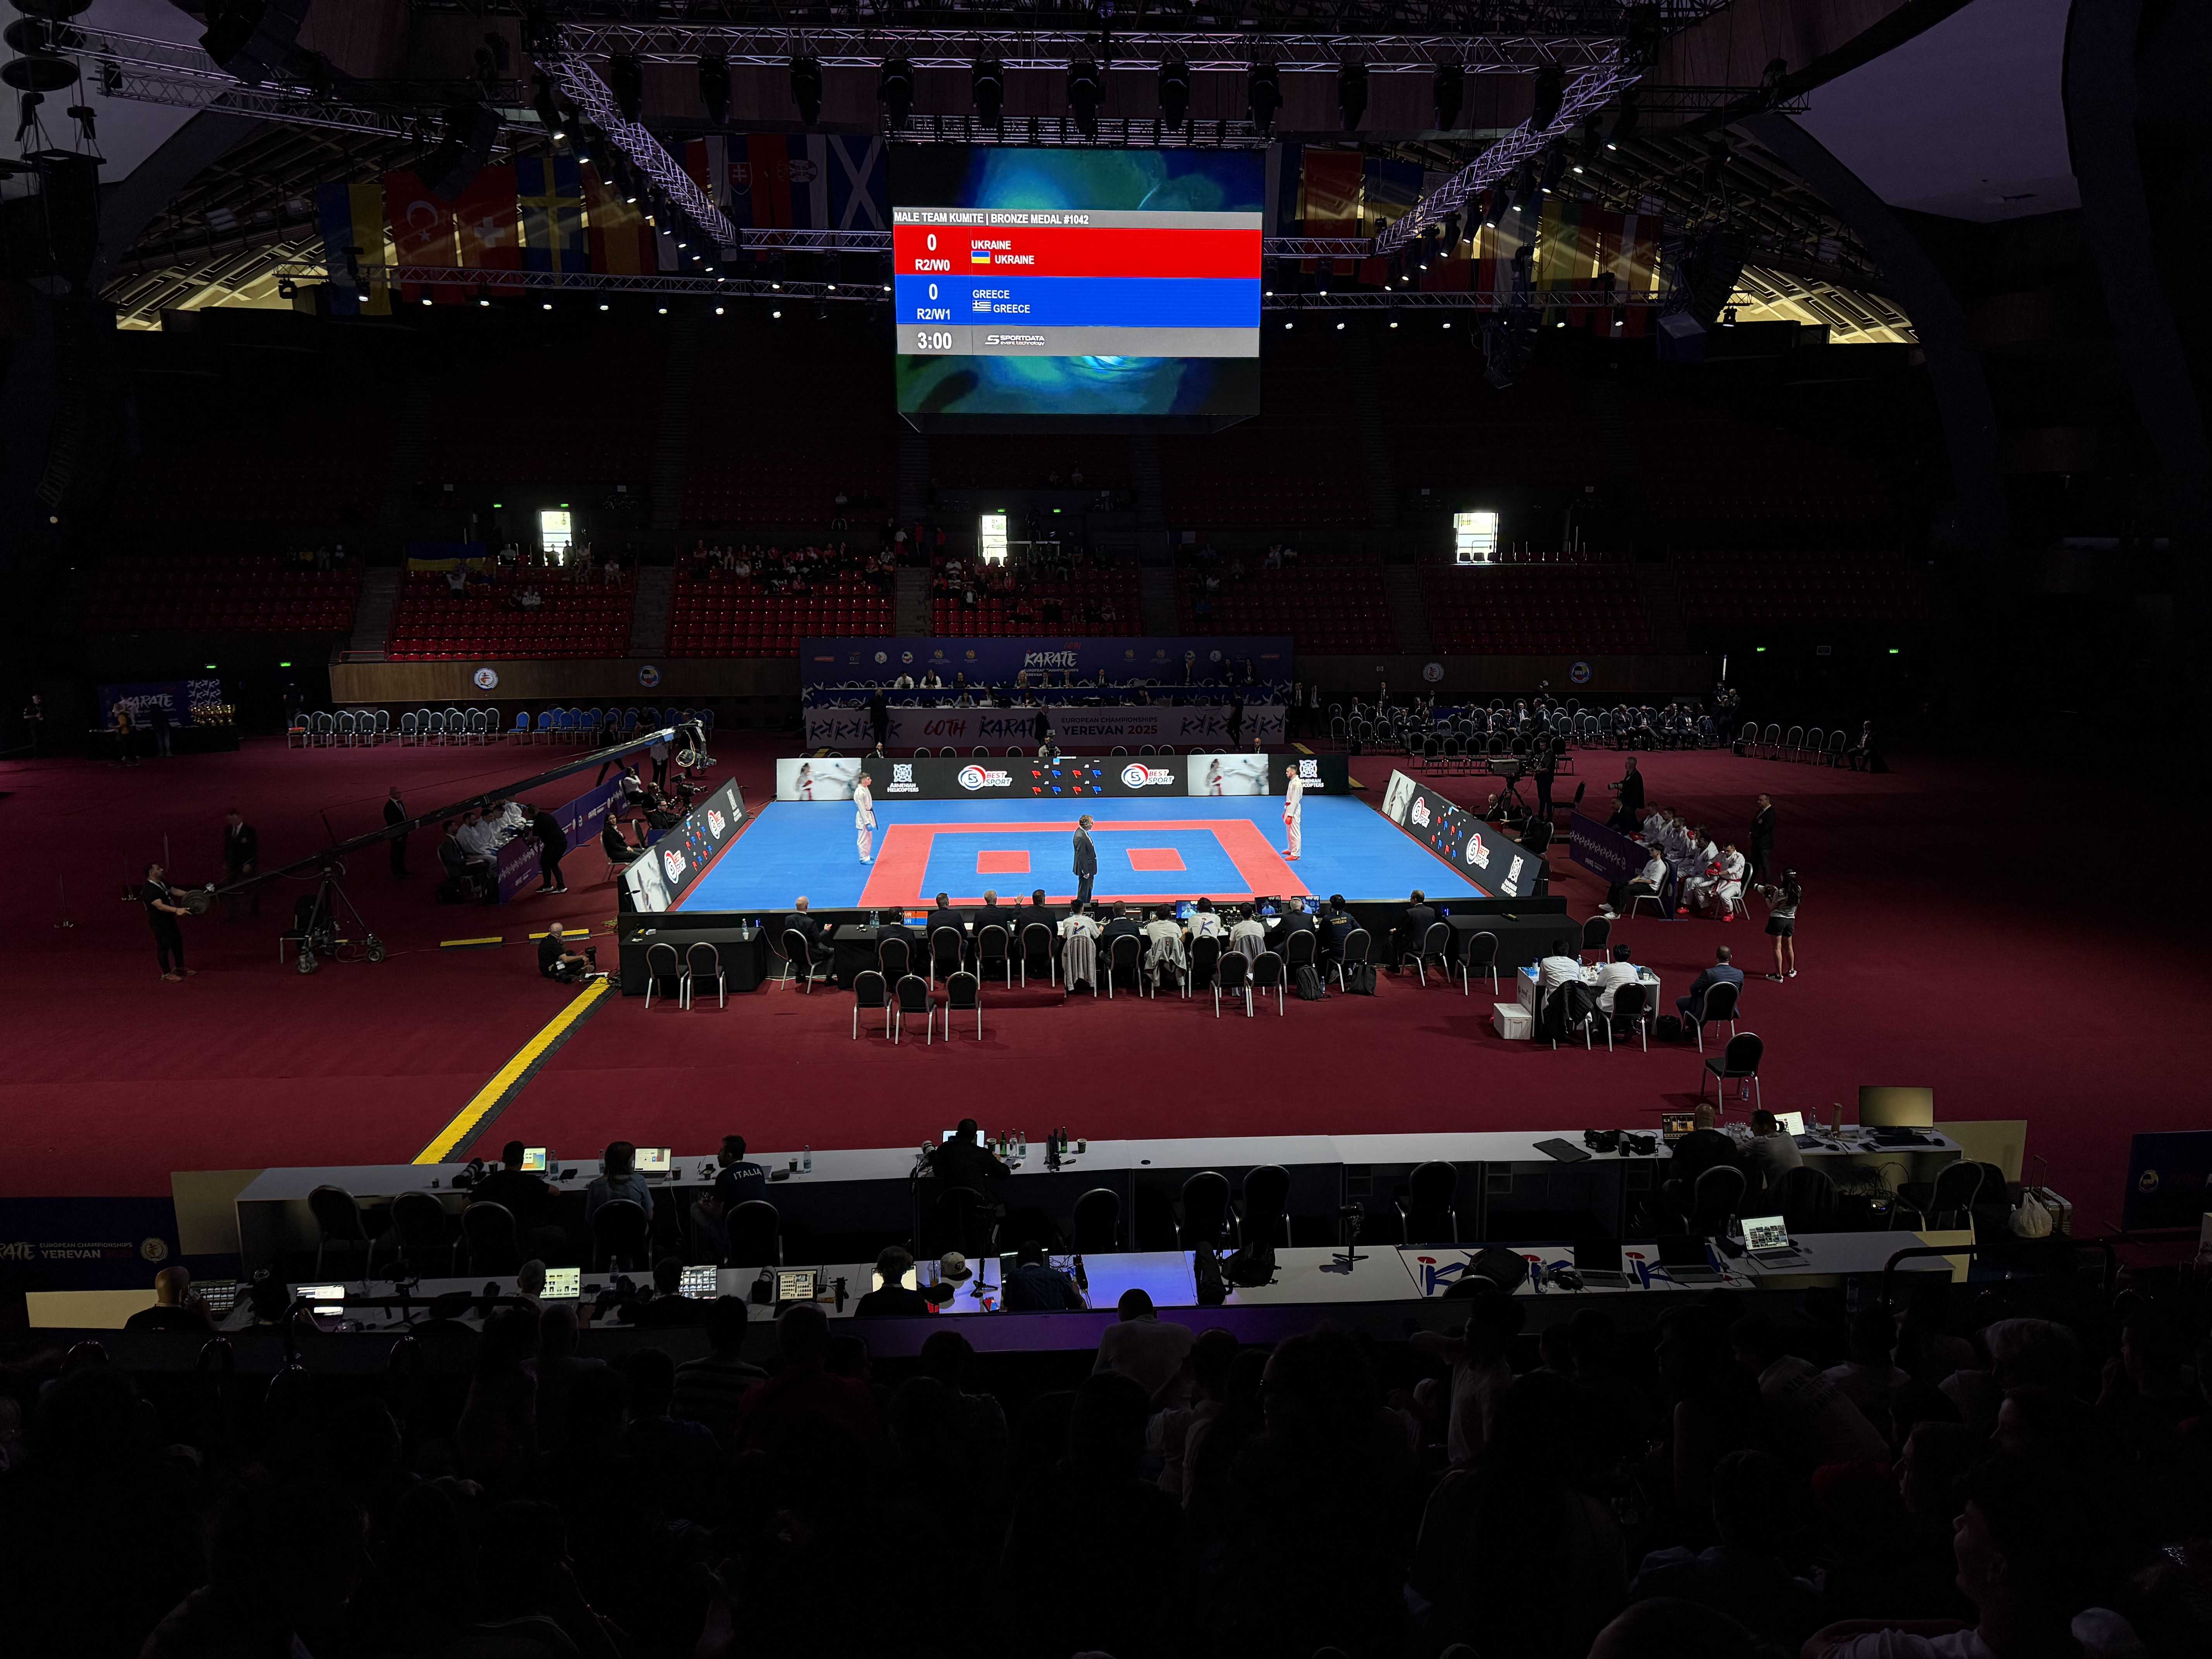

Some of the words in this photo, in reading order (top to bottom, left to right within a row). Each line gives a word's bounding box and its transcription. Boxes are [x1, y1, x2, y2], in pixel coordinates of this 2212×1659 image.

[894, 212, 919, 222] MALE
[922, 213, 947, 222] TEAM
[950, 213, 984, 223] KUMITE
[991, 213, 1029, 223] BRONZE
[1031, 214, 1062, 224] MEDAL
[1064, 215, 1089, 224] #1042
[927, 234, 937, 251] 0
[971, 240, 1012, 250] UKRAINE
[915, 259, 950, 271] R2/W0
[995, 255, 1035, 264] UKRAINE
[929, 283, 938, 300] 0
[972, 290, 1010, 299] GREECE
[917, 308, 950, 320] R2/W1
[993, 304, 1030, 314] GREECE
[917, 332, 952, 349] 3:00
[1024, 650, 1078, 668] KARATE
[924, 719, 967, 738] 60TH
[979, 716, 1036, 738] KARAT
[1062, 725, 1123, 735] YEREVAN
[1127, 725, 1158, 734] 2025
[733, 1168, 763, 1180] ITALIA
[41, 1250, 101, 1259] YEREVAN
